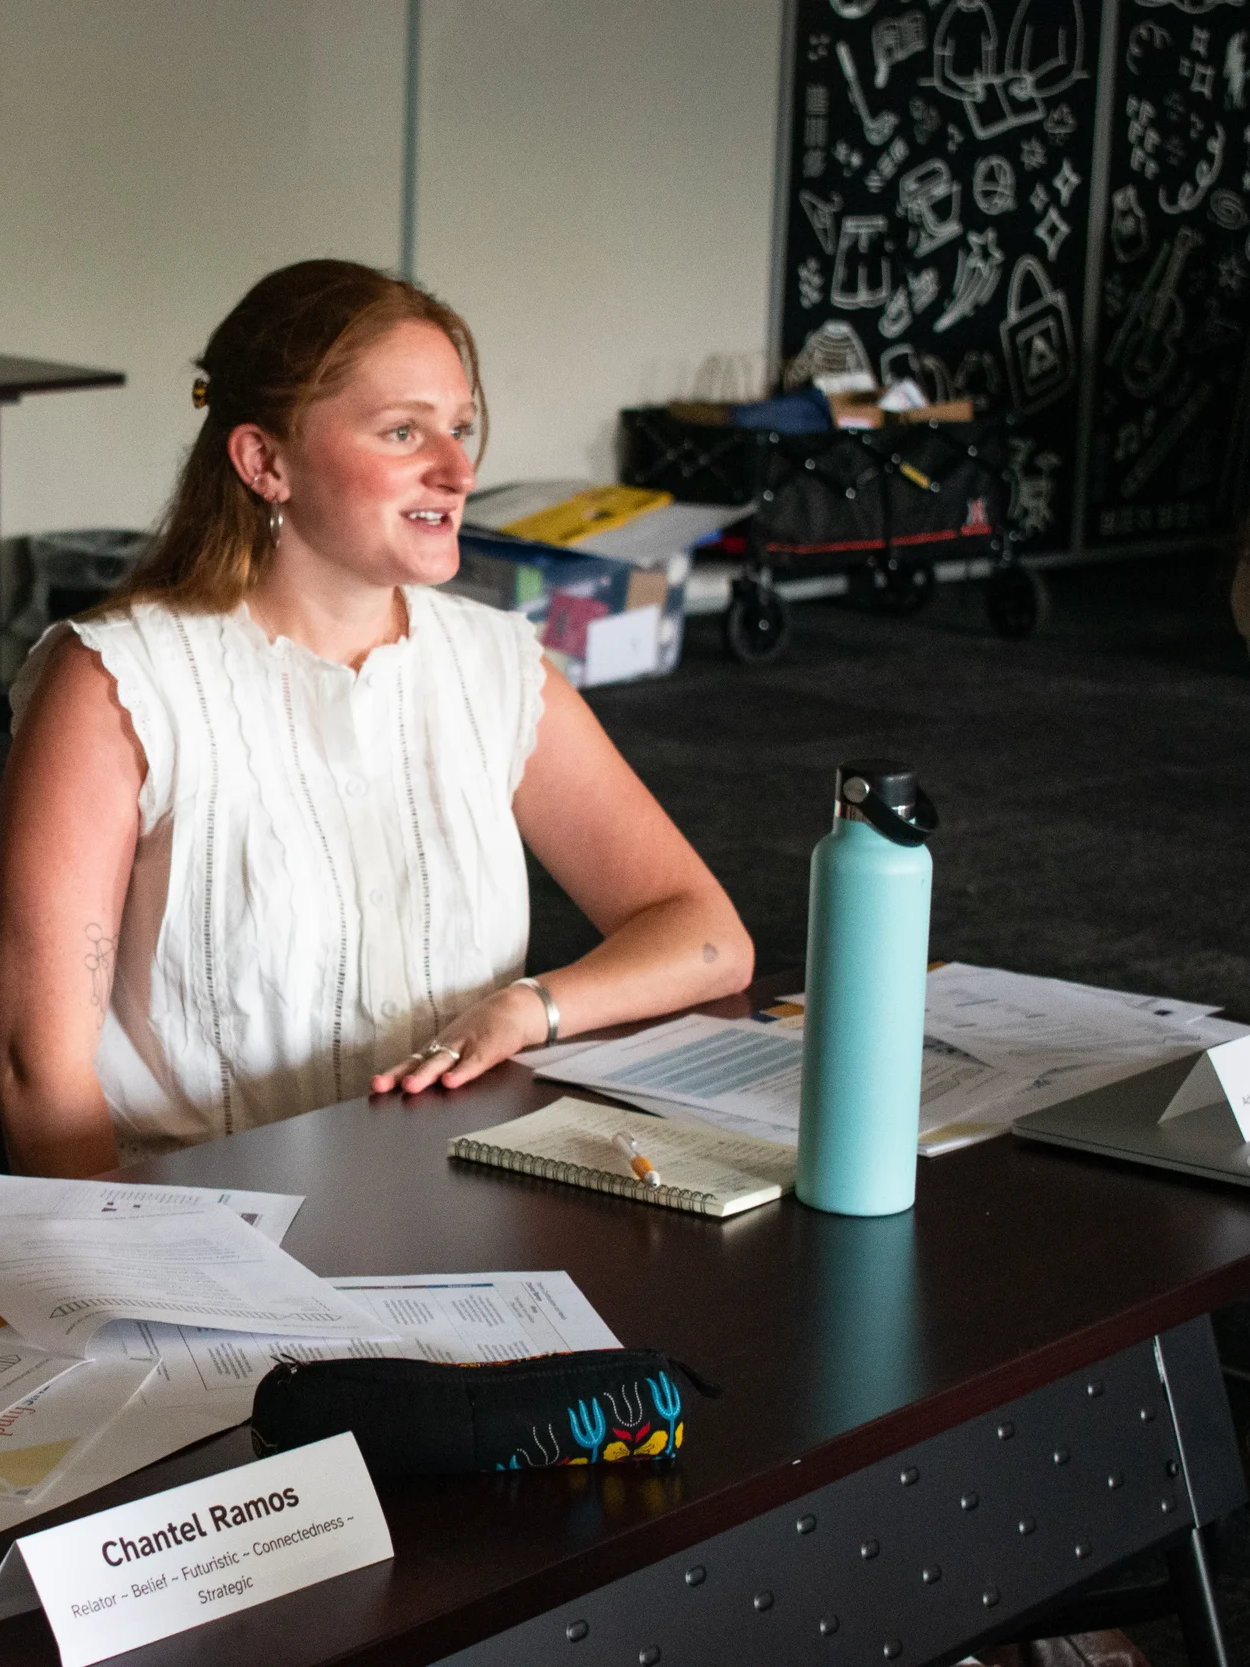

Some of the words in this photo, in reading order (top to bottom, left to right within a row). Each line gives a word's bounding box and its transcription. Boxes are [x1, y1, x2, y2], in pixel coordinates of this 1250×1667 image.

[70, 1594, 117, 1619] Relator
[131, 1573, 169, 1599] Belief
[181, 1551, 241, 1581] Futuristic
[252, 1516, 345, 1557] Connectedness
[101, 1512, 208, 1568] Chantel
[209, 1486, 300, 1533] Ramos
[197, 1576, 254, 1605] Strategic
